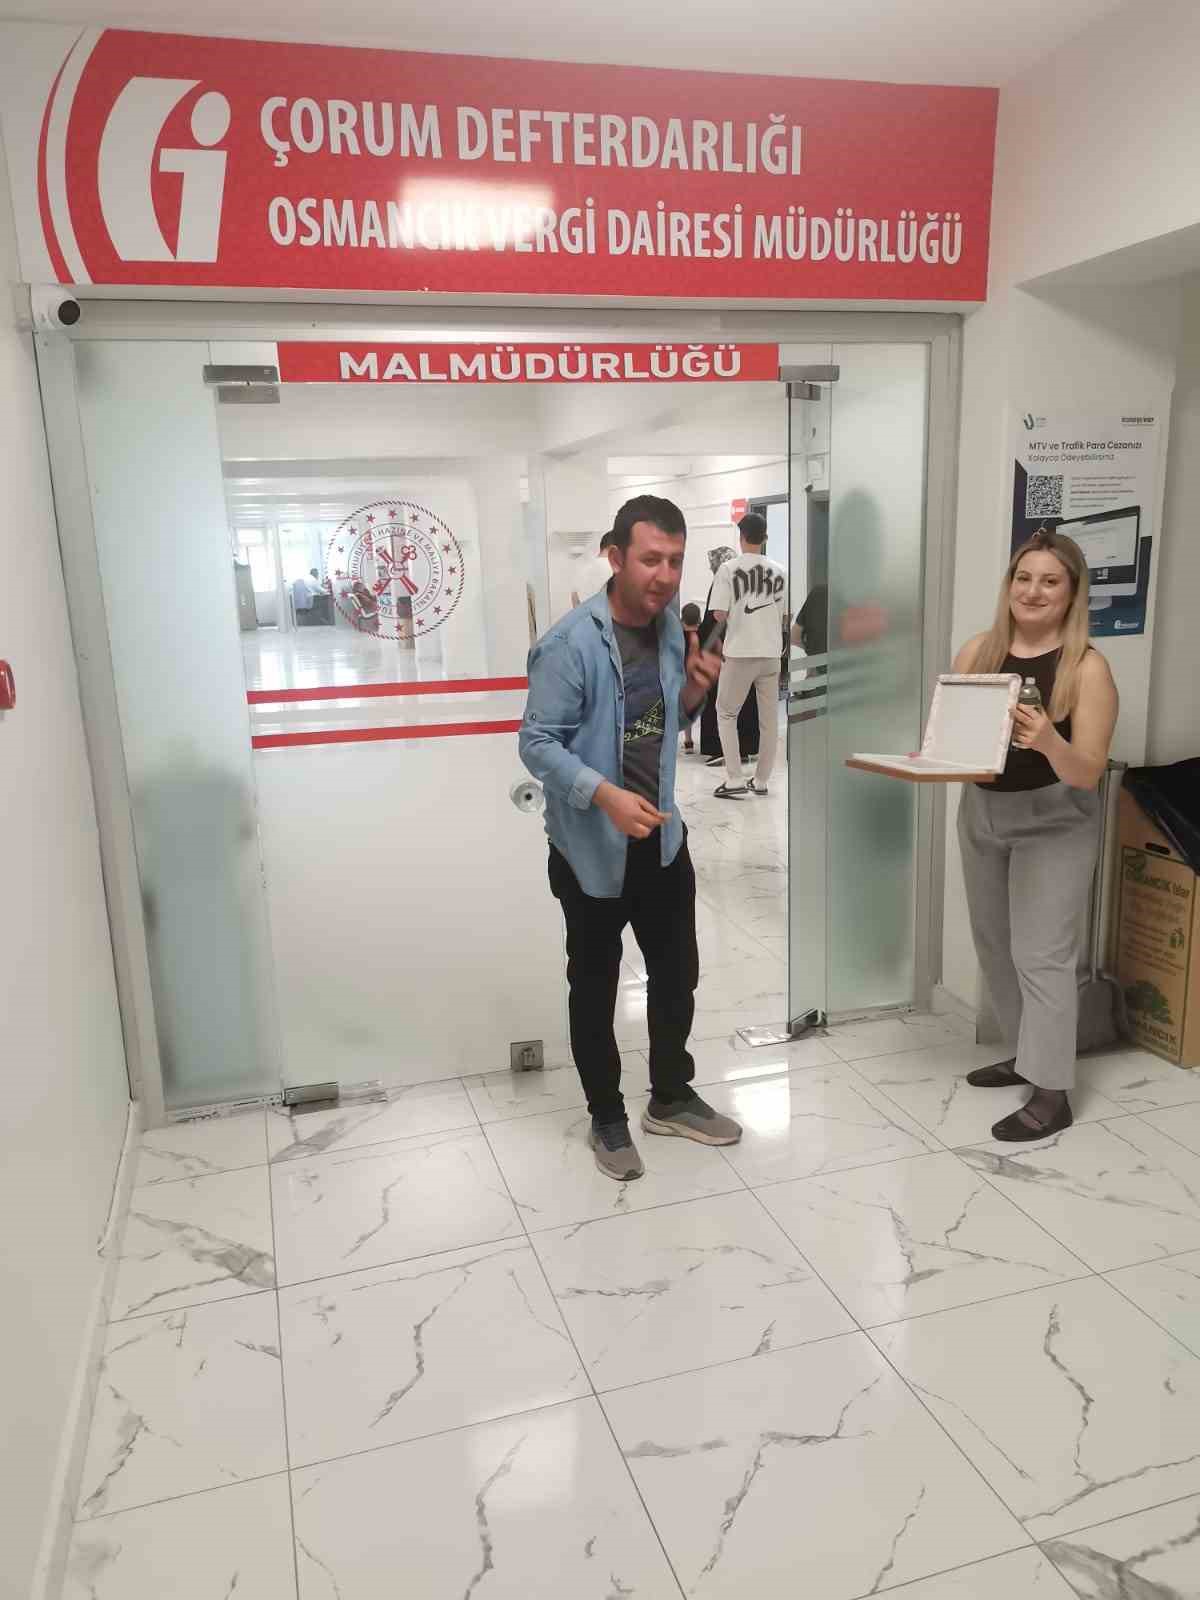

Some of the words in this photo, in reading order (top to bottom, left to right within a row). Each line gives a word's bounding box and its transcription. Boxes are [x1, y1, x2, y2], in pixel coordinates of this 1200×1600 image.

[260, 95, 443, 168] ÇORUM
[456, 106, 803, 176] DEFTERDARLIĞI
[268, 197, 480, 251] OSMANCIK
[484, 198, 597, 255] VERGİ
[607, 201, 742, 259] DAİRESİ
[754, 206, 962, 264] MÜDÜRLÜĞÜ
[338, 343, 742, 381] MALMÜDÜRLÜĞÜ
[1029, 441, 1048, 450] MTV
[1061, 441, 1084, 450] Trafik
[1086, 441, 1106, 450] Para
